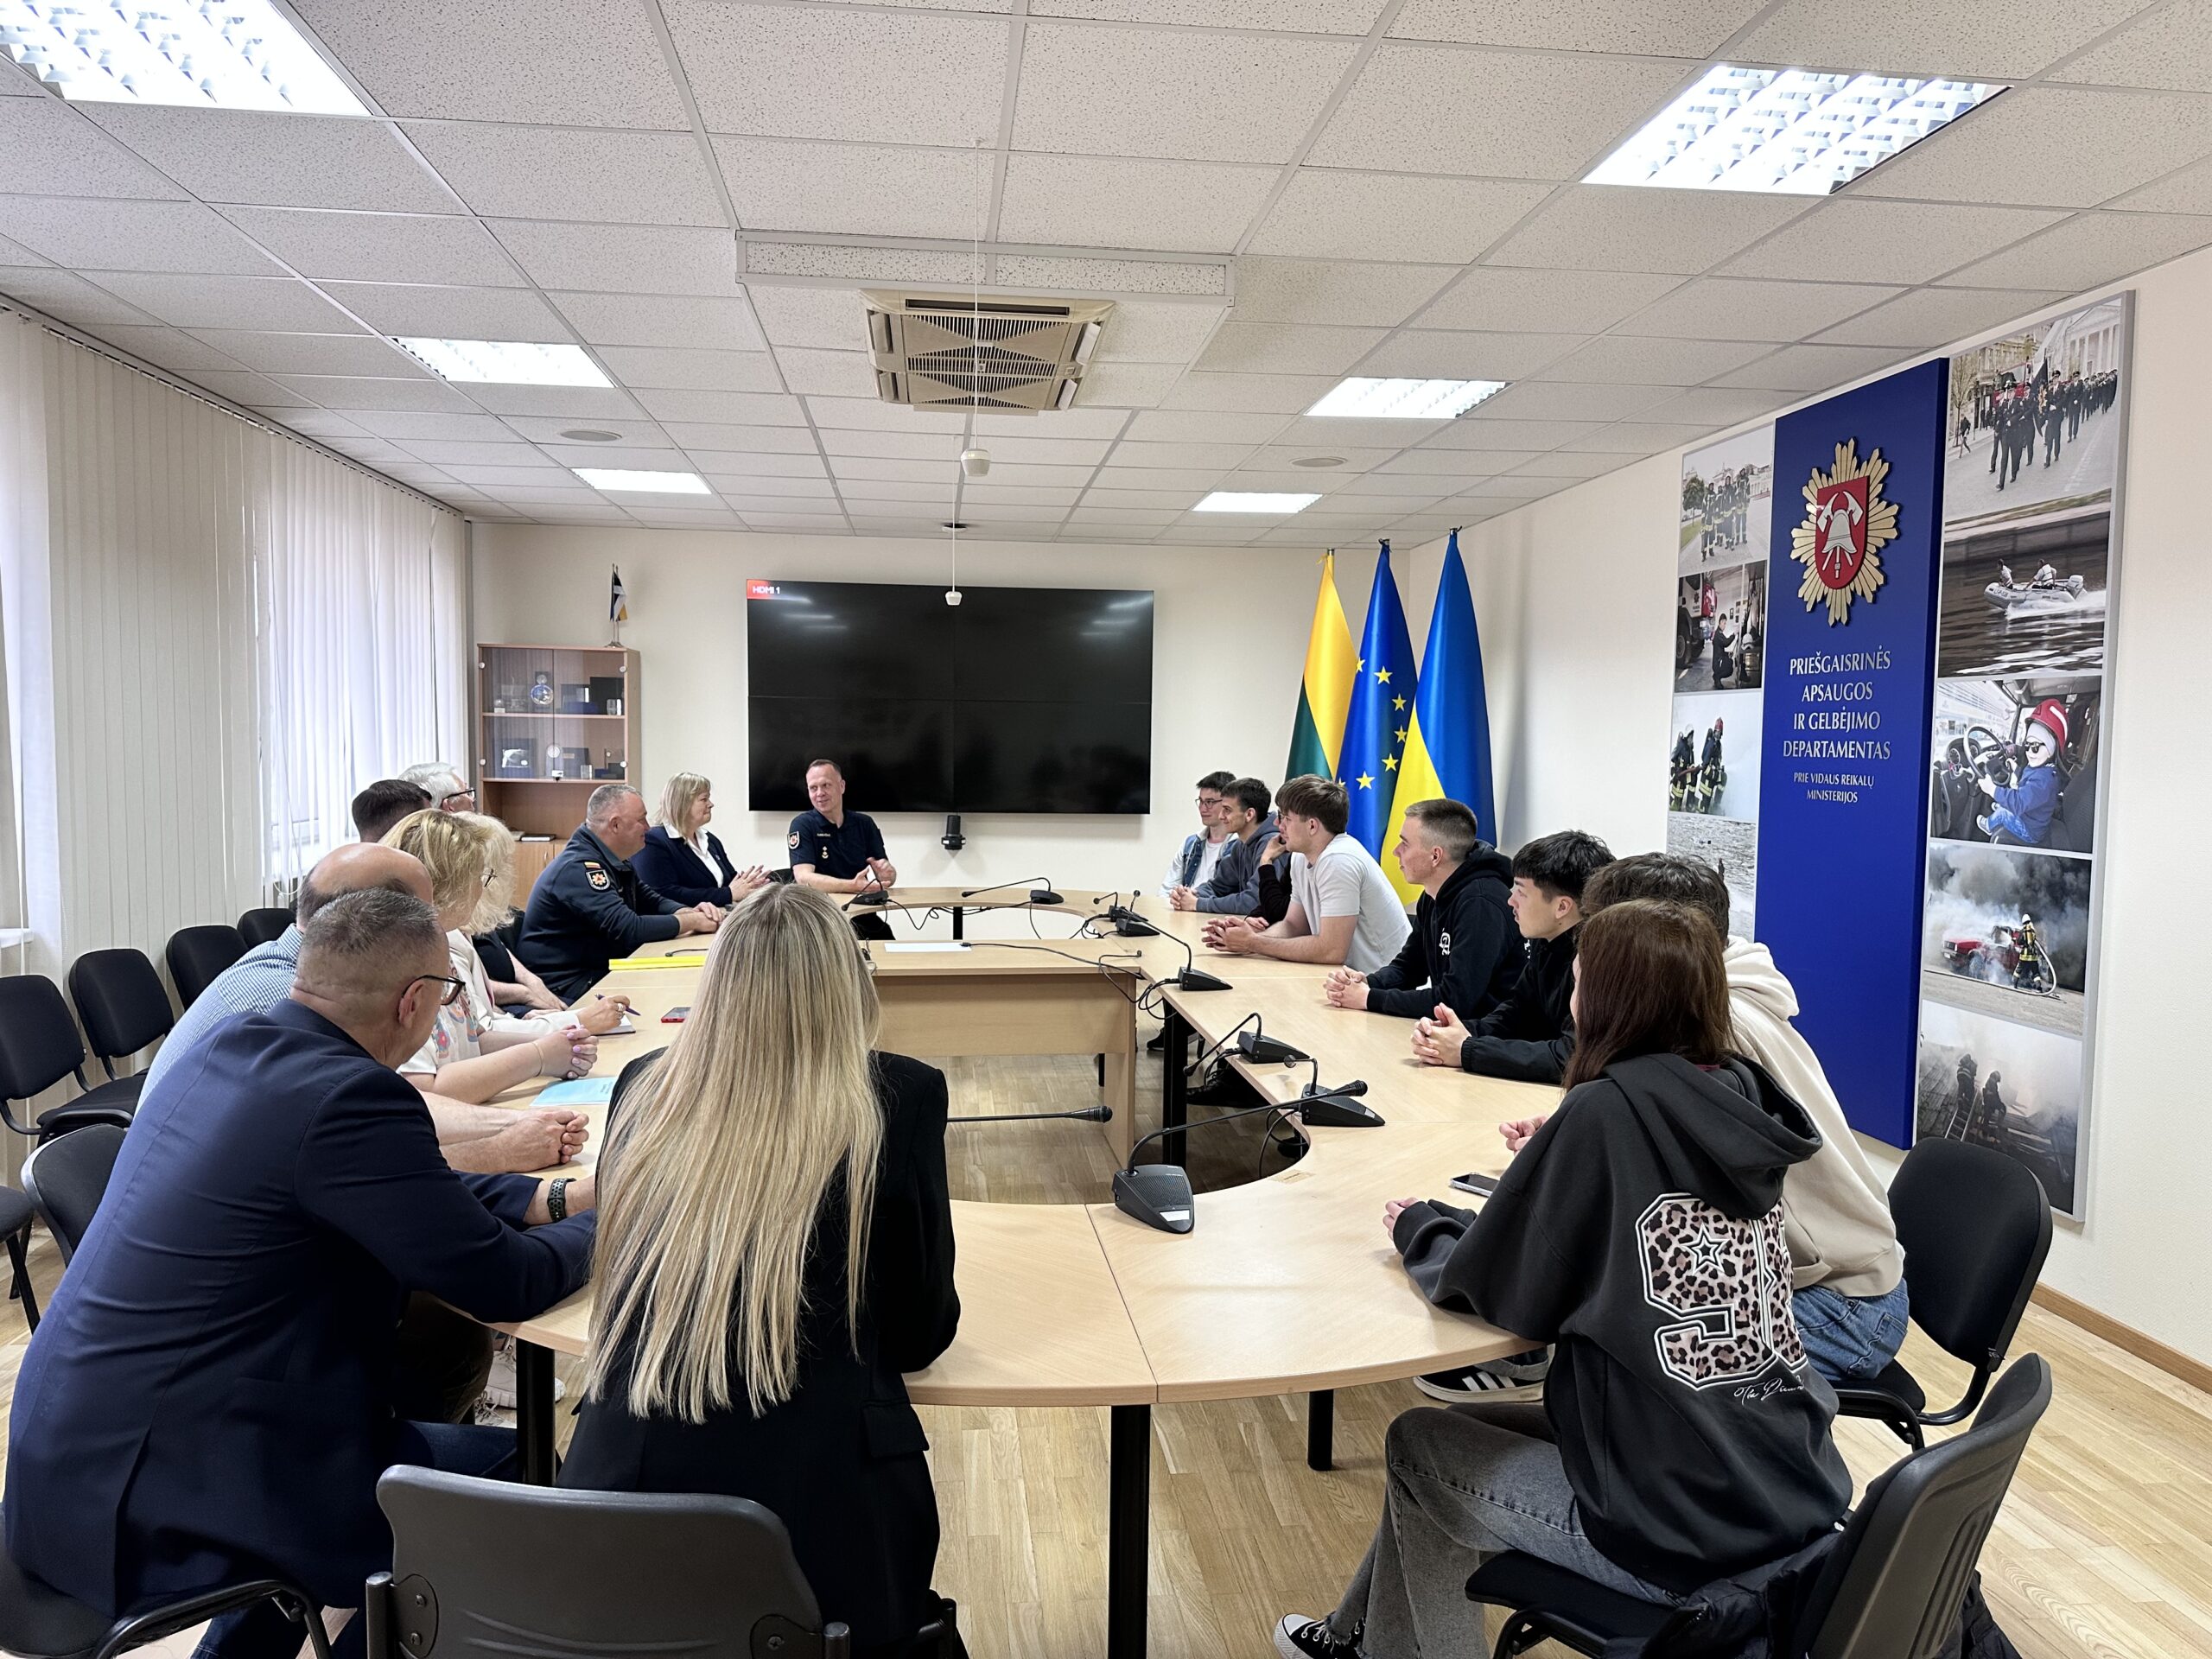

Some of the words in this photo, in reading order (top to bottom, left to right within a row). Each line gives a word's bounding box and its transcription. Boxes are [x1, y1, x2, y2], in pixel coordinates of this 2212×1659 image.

[753, 586, 774, 594] HDMI
[776, 586, 780, 594] 1
[1789, 645, 1891, 676] PRIEŠGAISRINĖS
[1802, 681, 1873, 702] APSAUGOS
[1793, 712, 1805, 730] IR
[1808, 706, 1881, 733] GELBĖJIMO
[1783, 741, 1891, 760] DEPARTAMENTAS
[1794, 772, 1808, 784] PRIE
[1810, 772, 1840, 785] VIDAUS
[1840, 774, 1875, 790] REIKALŲ
[1806, 789, 1859, 804] MINISTERIJOS
[1733, 1382, 1764, 1407] The
